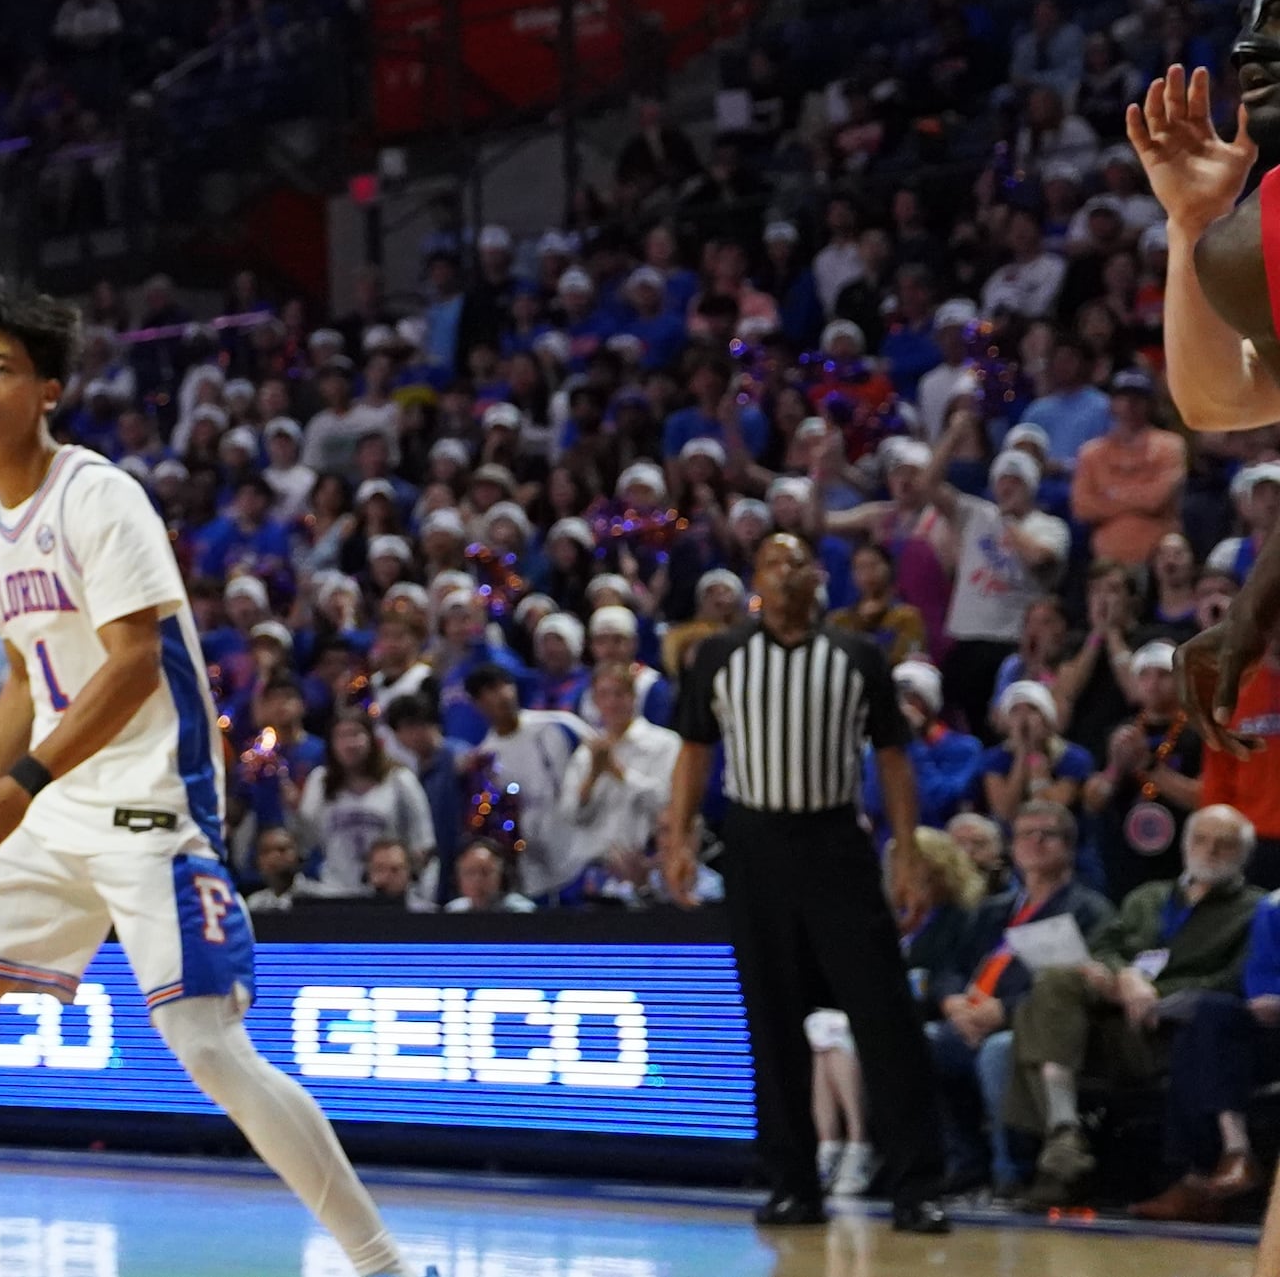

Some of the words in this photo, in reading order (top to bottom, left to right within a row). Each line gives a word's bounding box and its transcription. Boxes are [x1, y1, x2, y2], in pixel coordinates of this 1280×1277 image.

[35, 640, 70, 712] 1
[194, 875, 233, 944] F
[292, 986, 648, 1087] GEICO
